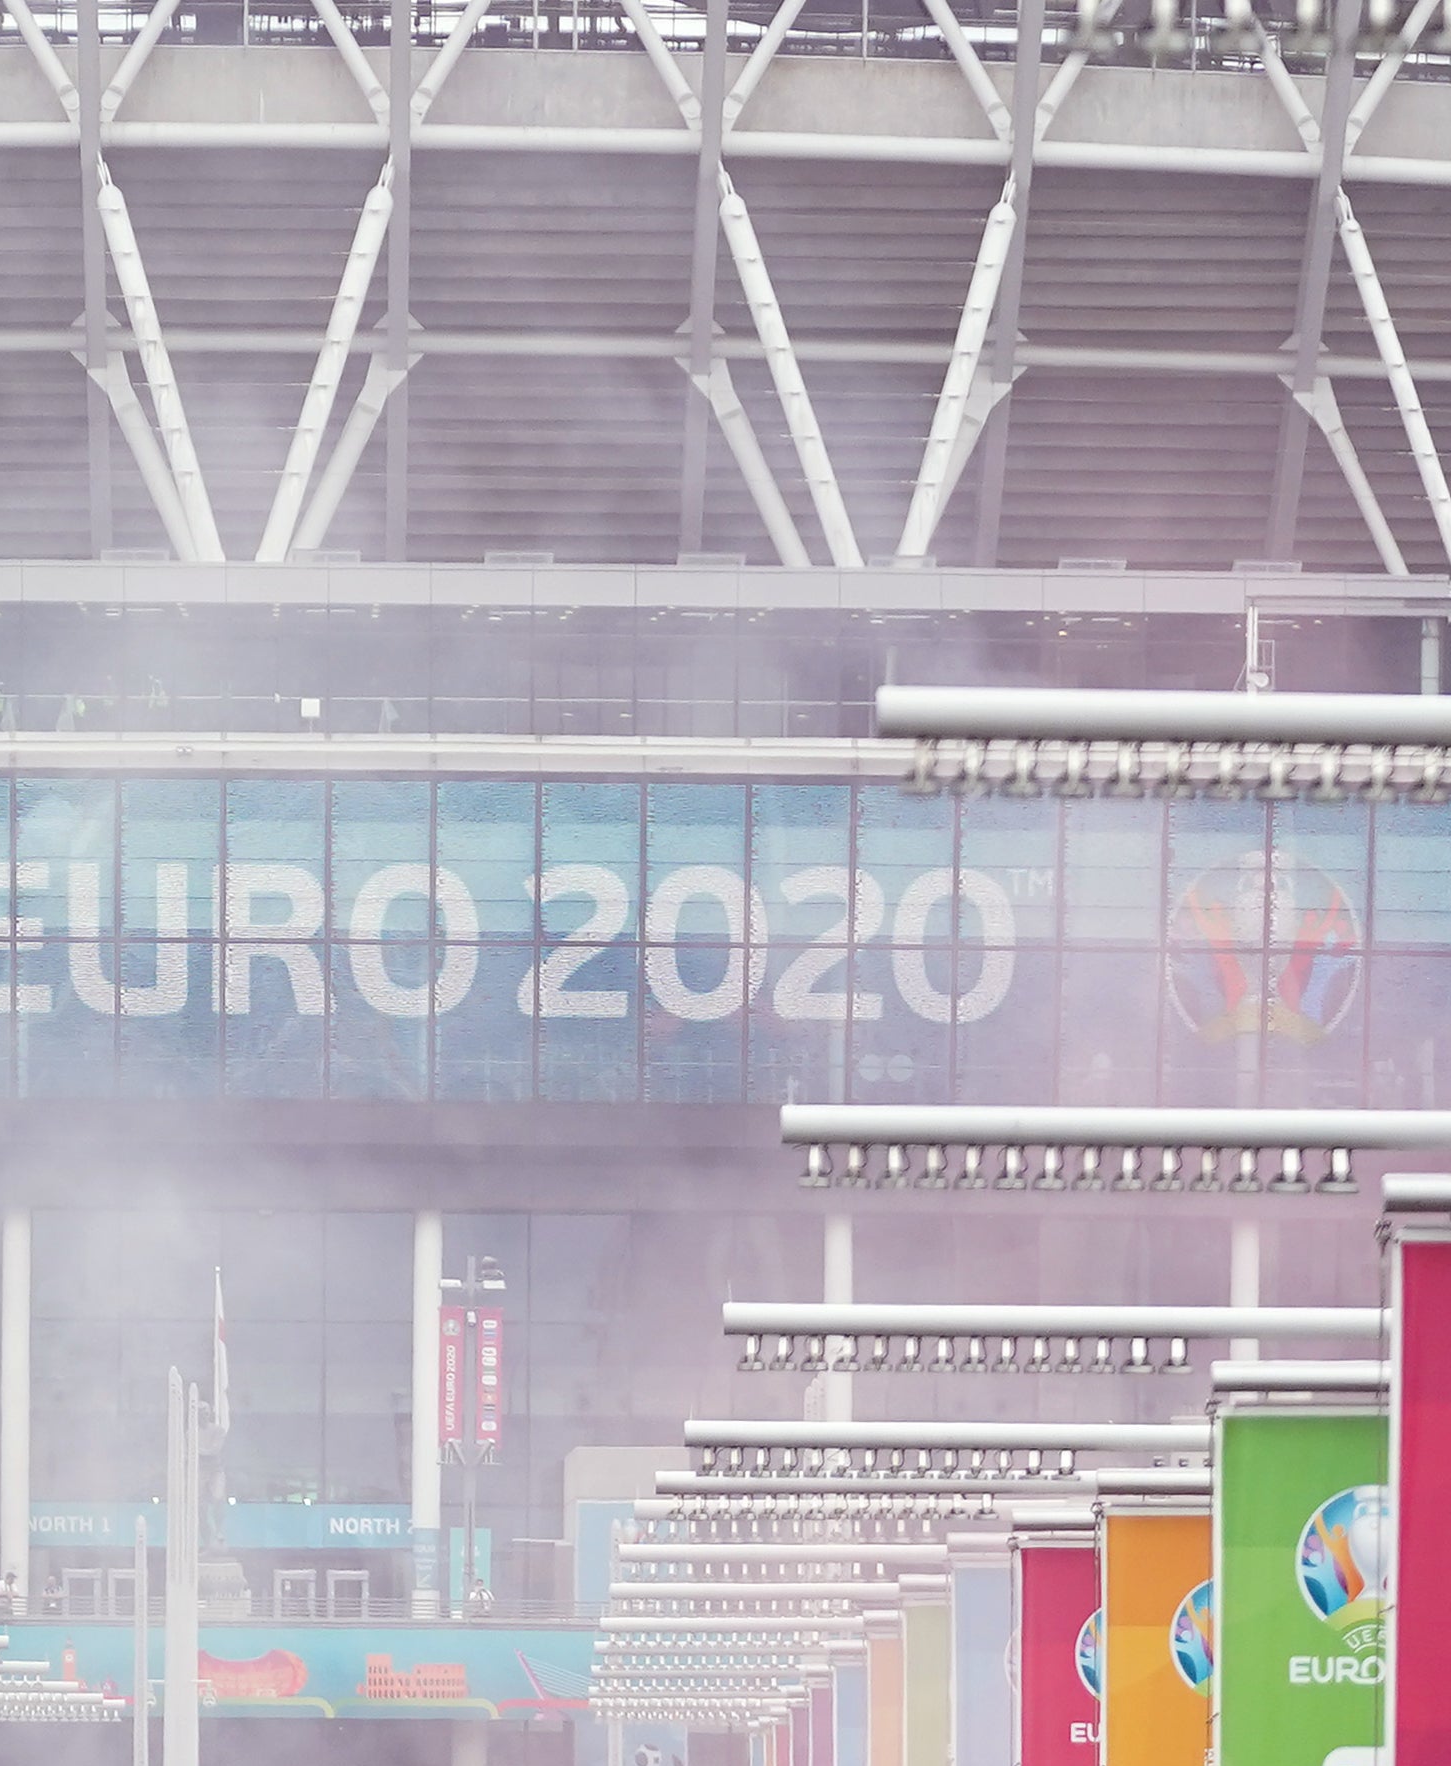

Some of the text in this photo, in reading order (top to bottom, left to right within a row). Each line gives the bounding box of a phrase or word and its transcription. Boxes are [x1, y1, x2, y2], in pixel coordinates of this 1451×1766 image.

[517, 863, 1016, 1025] 2020
[102, 1516, 111, 1532] 1
[330, 1516, 400, 1534] NORTH
